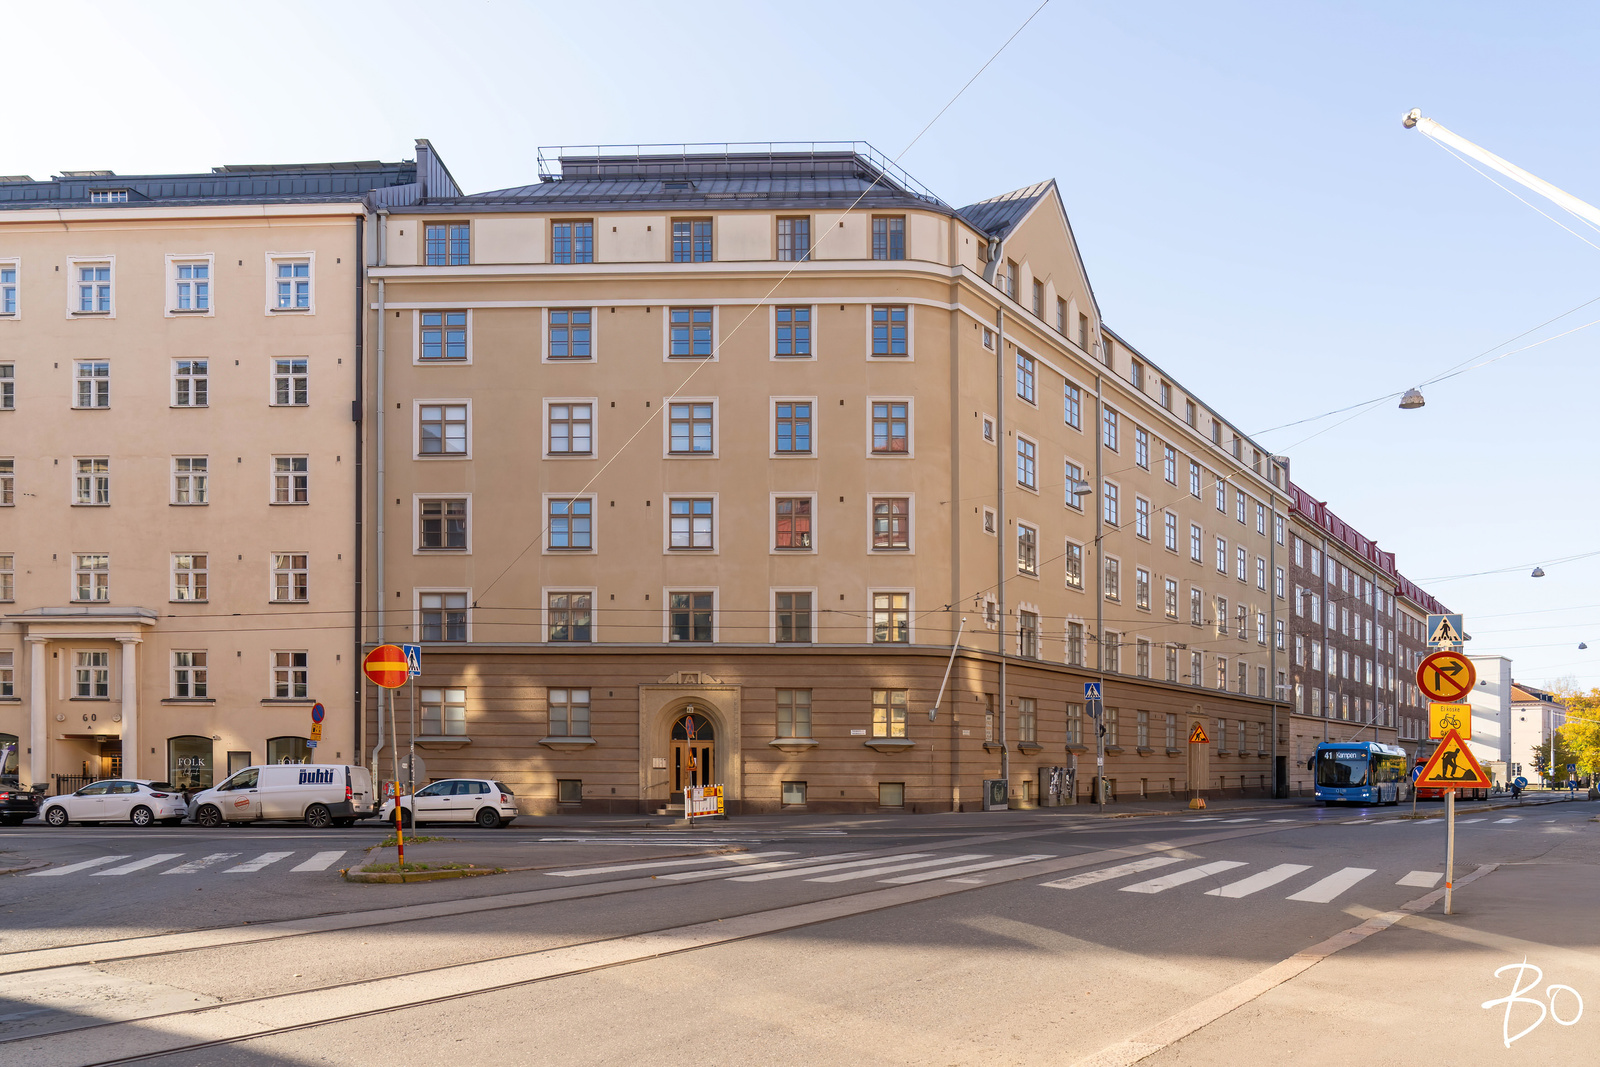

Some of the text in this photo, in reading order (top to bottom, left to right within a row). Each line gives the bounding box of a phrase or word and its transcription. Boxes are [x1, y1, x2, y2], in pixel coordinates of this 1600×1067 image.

[82, 713, 97, 722] 60
[1324, 751, 1333, 759] 41
[178, 758, 205, 766] FOLK
[299, 768, 334, 785] puhti
